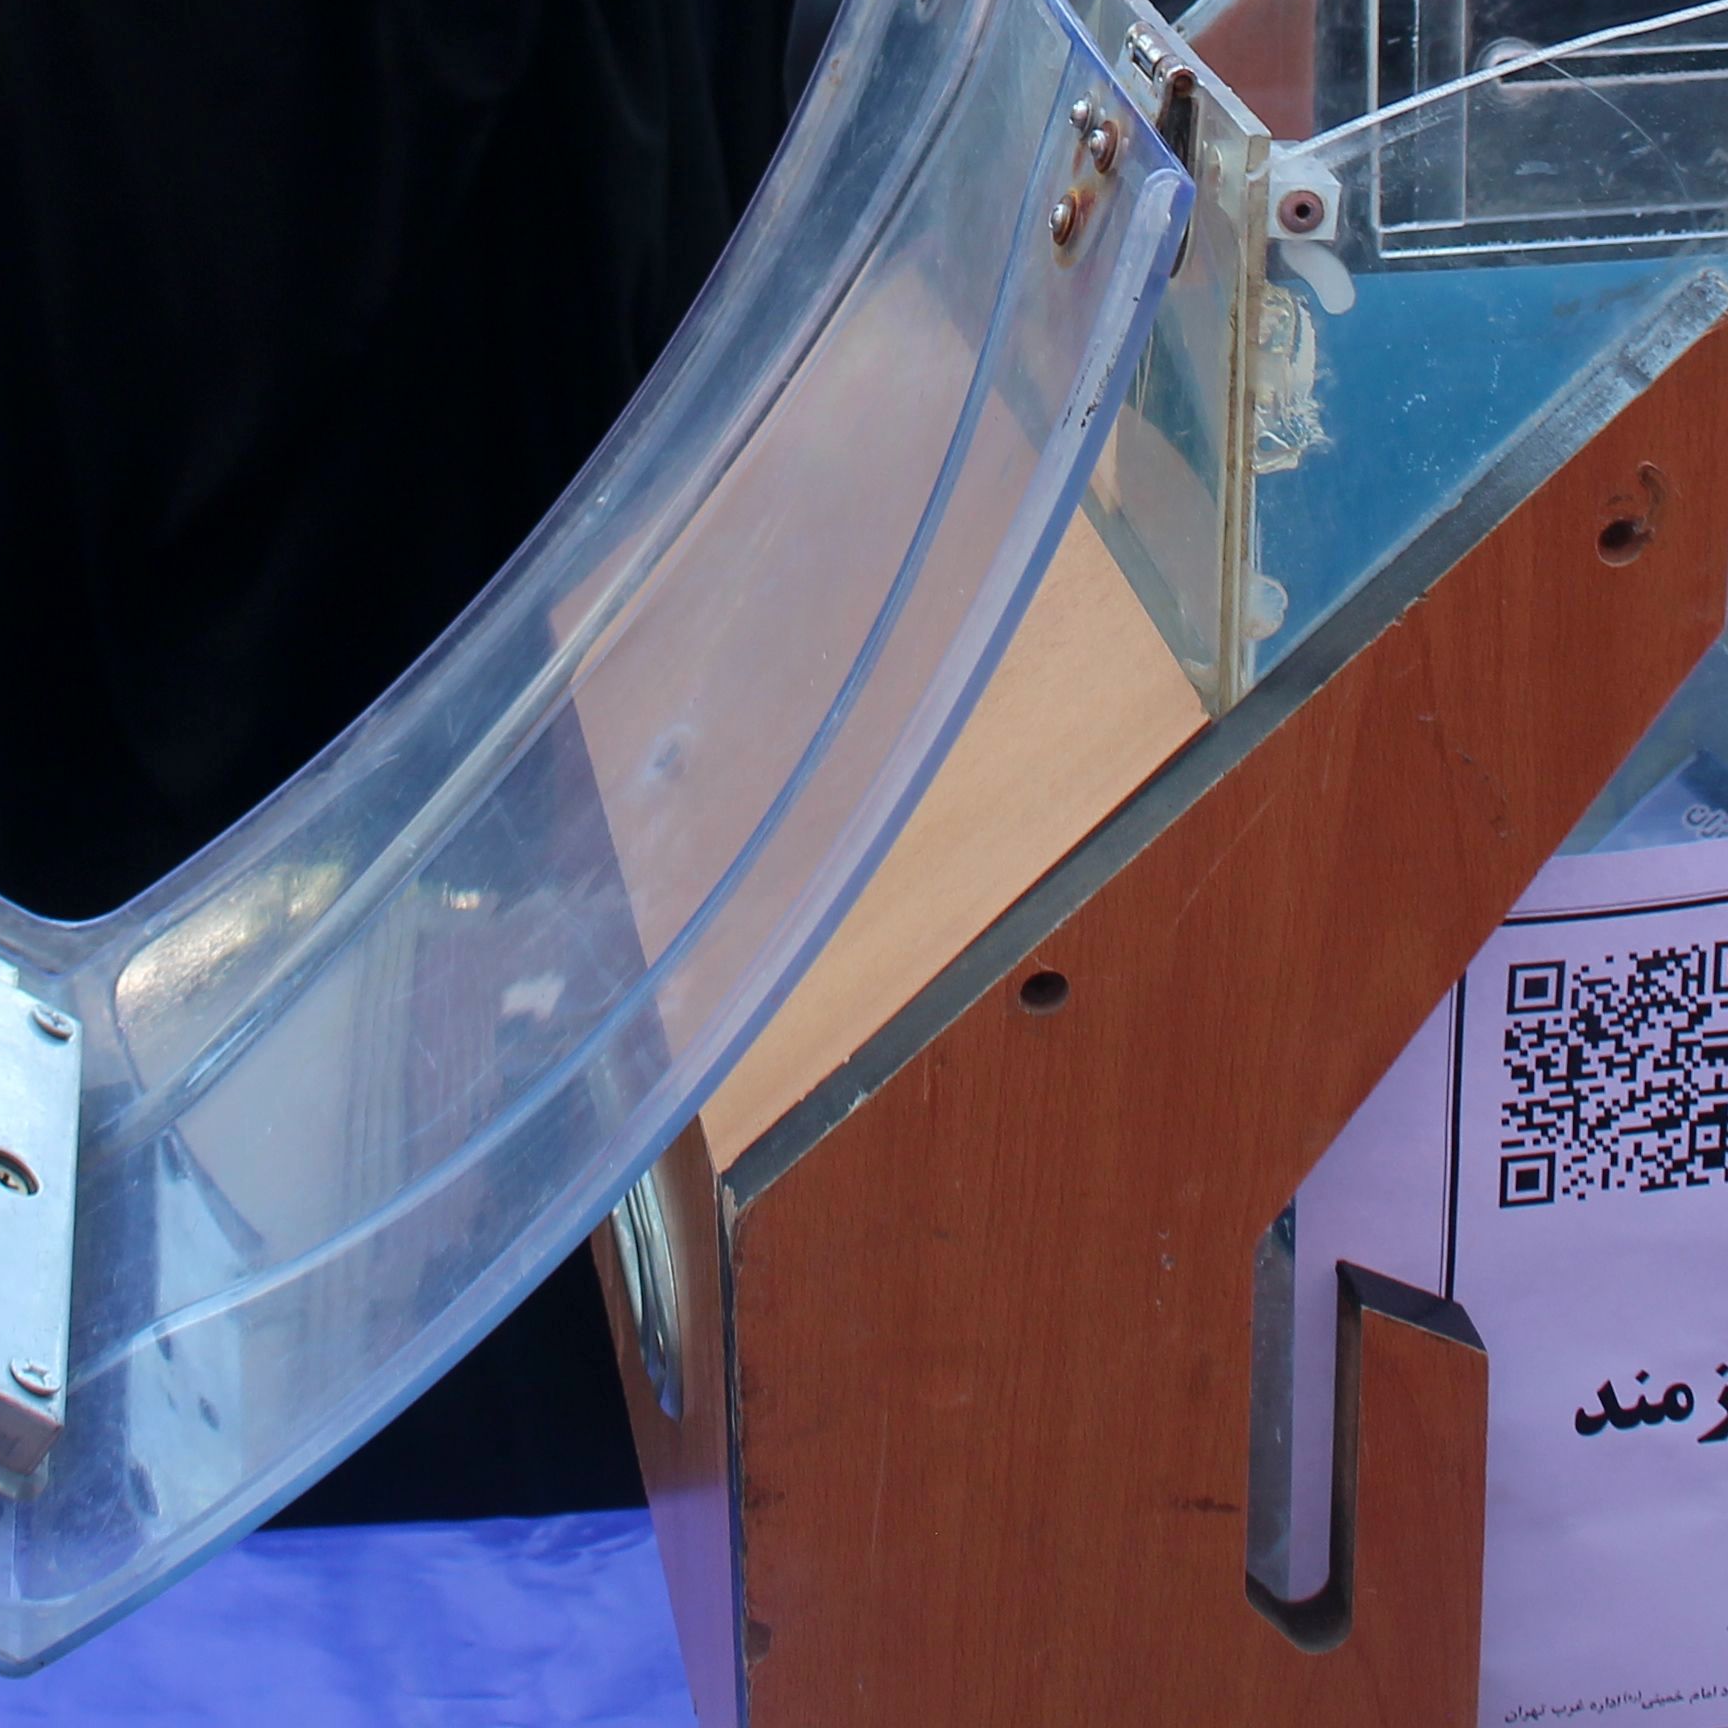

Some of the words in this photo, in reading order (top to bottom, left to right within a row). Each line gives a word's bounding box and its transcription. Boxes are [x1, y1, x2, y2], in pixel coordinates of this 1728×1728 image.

[1589, 1694, 1622, 1715] اداره
[1688, 1685, 1718, 1705] امام
[1504, 1704, 1547, 1724] تهران
